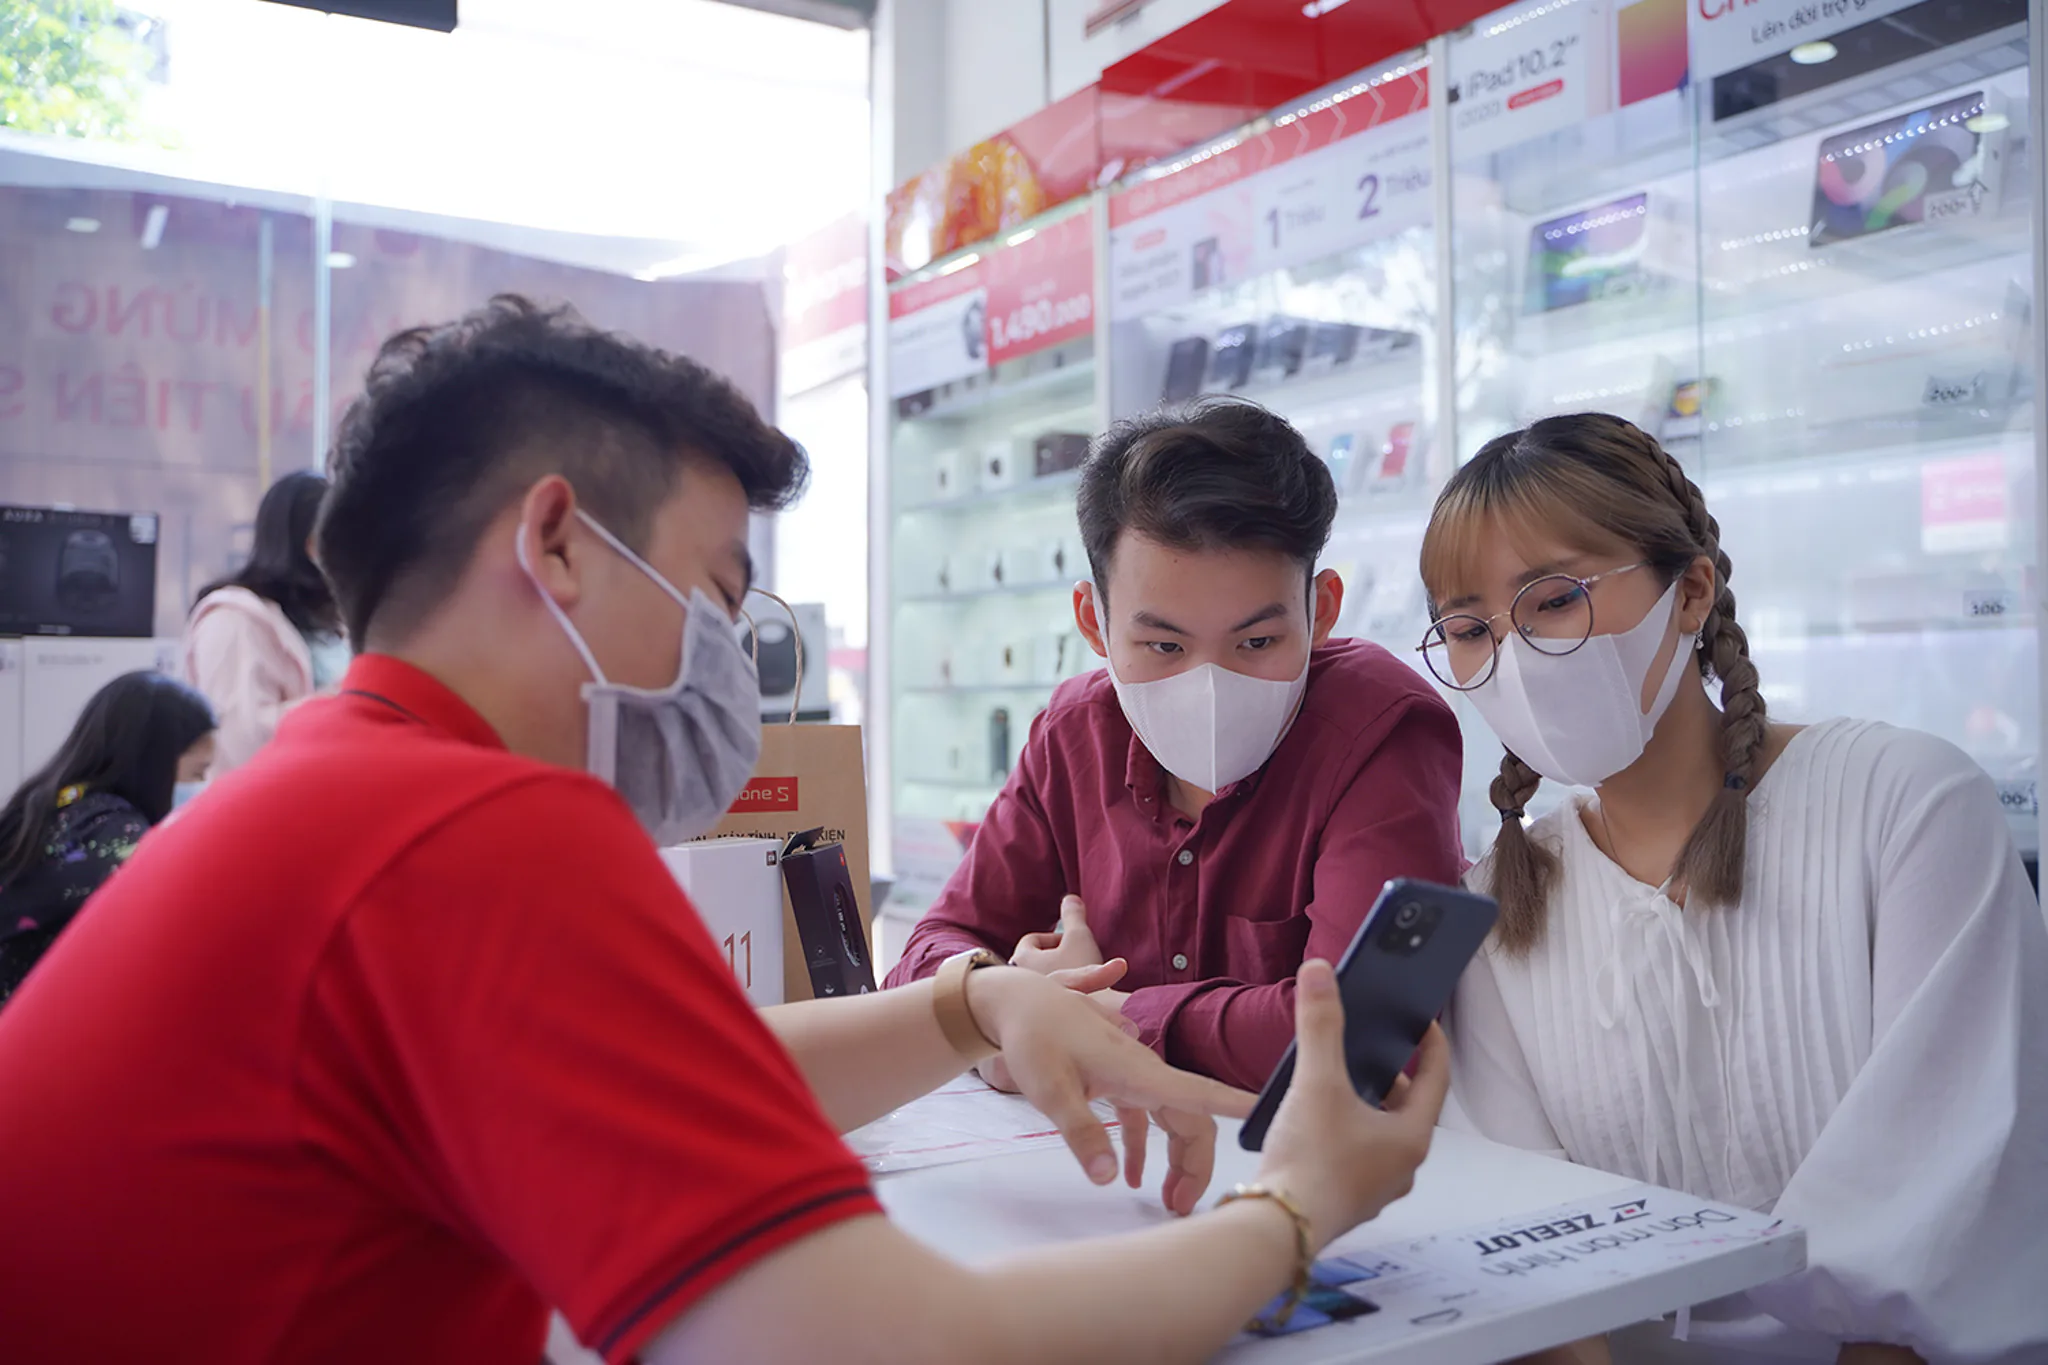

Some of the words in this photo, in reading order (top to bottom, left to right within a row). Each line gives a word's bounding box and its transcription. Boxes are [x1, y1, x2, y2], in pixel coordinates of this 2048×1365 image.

[1465, 58, 1516, 100] iPad
[1356, 173, 1380, 220] 2
[1267, 207, 1279, 249] 1
[736, 788, 772, 801] one
[1474, 1213, 1606, 1256] ZEELOT
